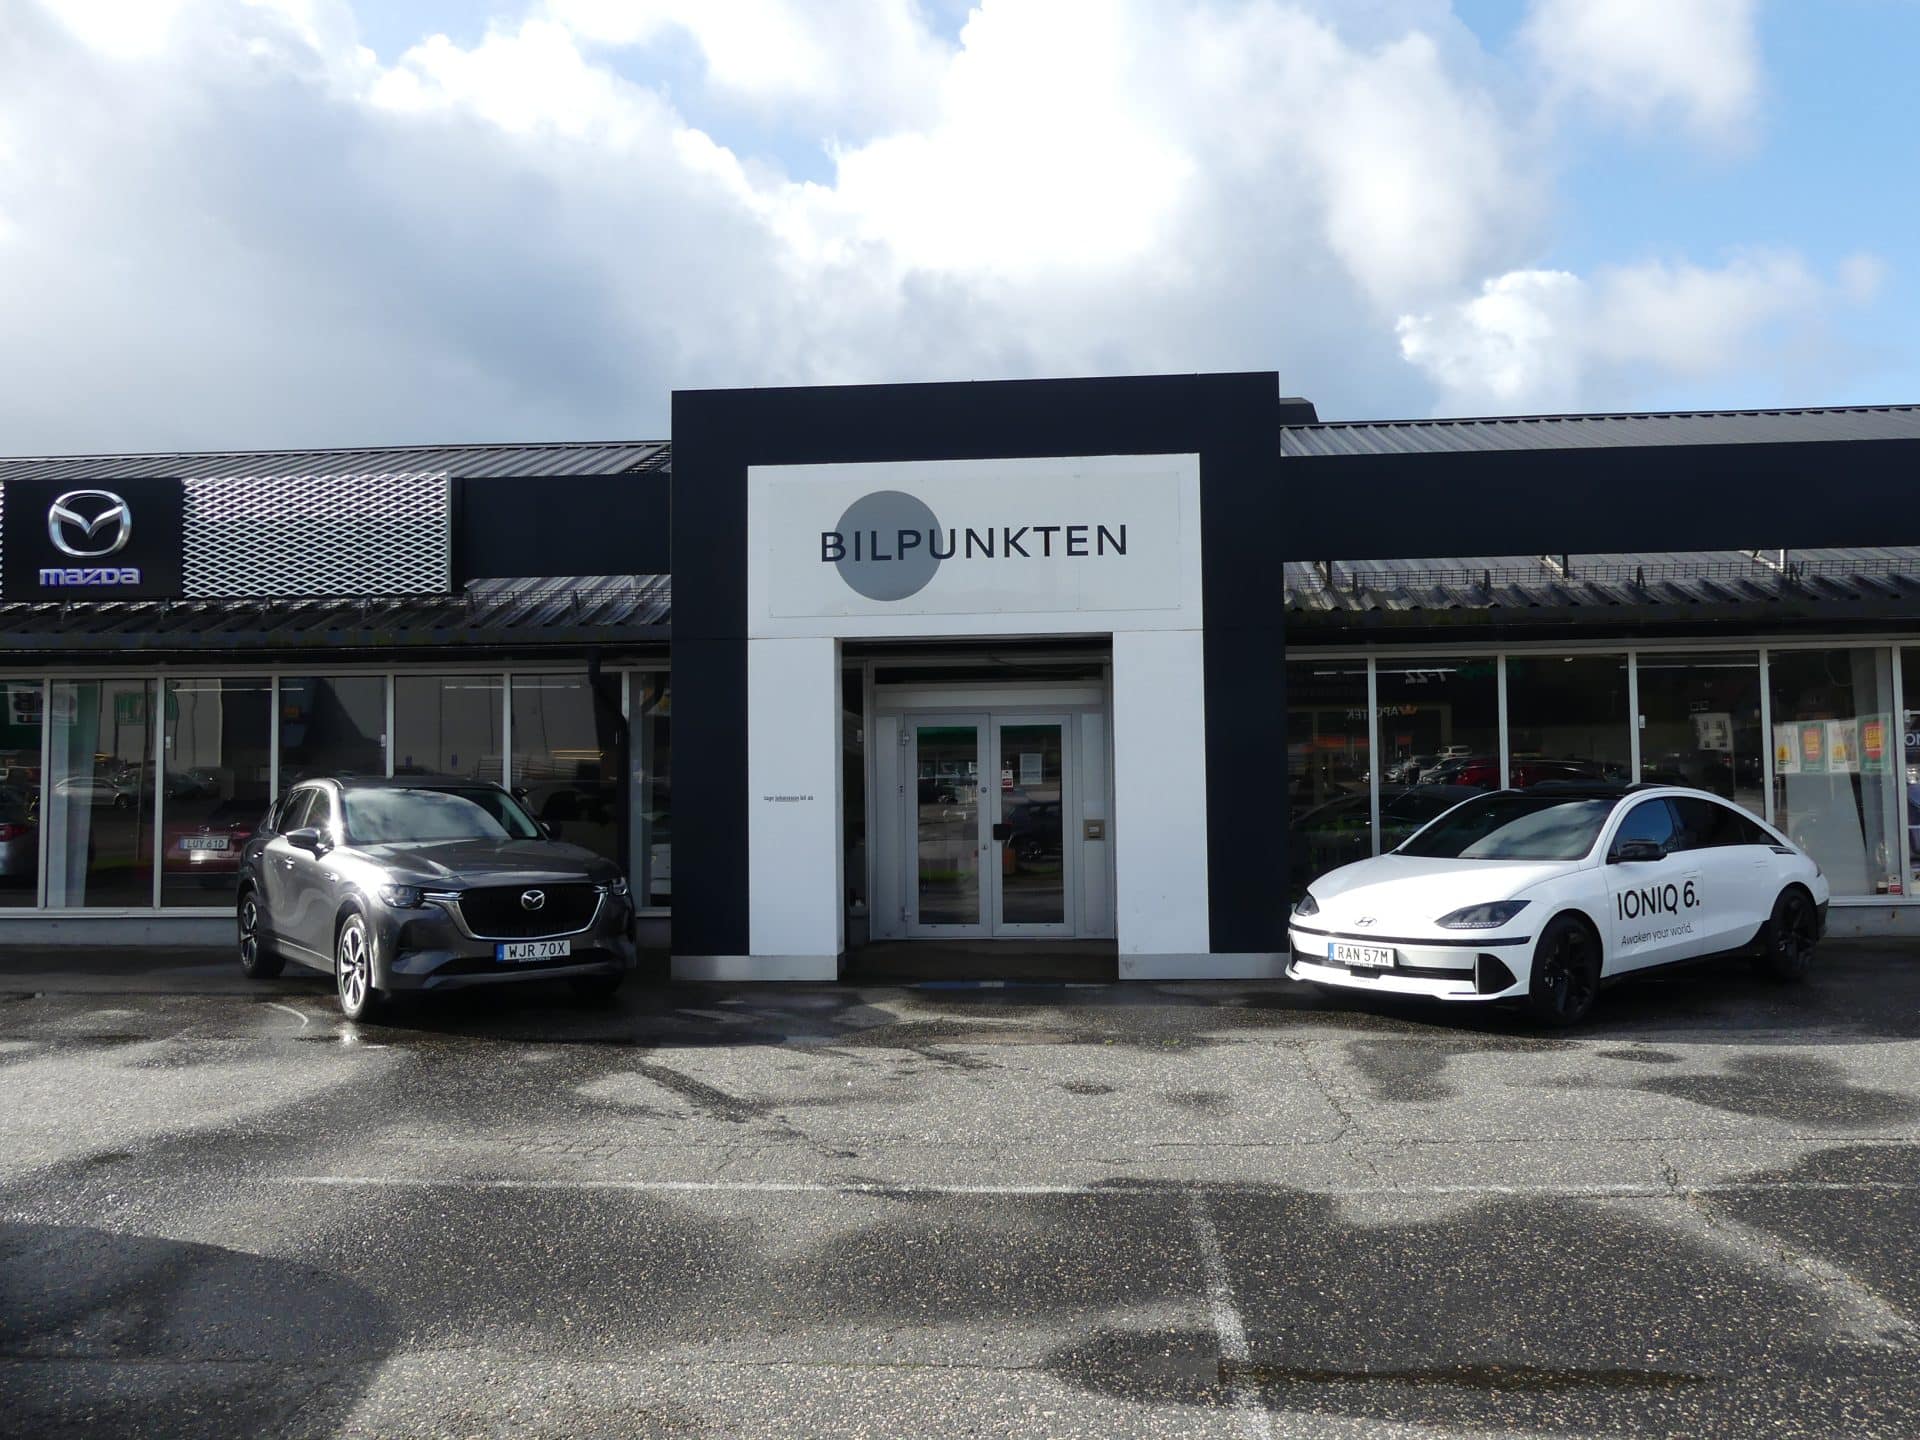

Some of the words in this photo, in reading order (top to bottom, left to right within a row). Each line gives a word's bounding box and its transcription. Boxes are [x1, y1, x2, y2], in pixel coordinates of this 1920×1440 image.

[820, 524, 1127, 562] BILPUNKTEN
[1617, 883, 1679, 921] IONIQ
[1683, 880, 1700, 908] 6.
[1621, 931, 1652, 946] Awaken
[1652, 928, 1669, 942] your
[509, 944, 535, 958] WJR
[540, 942, 565, 956] 70X
[1337, 946, 1360, 960] RAN
[1363, 948, 1389, 964] 57M
